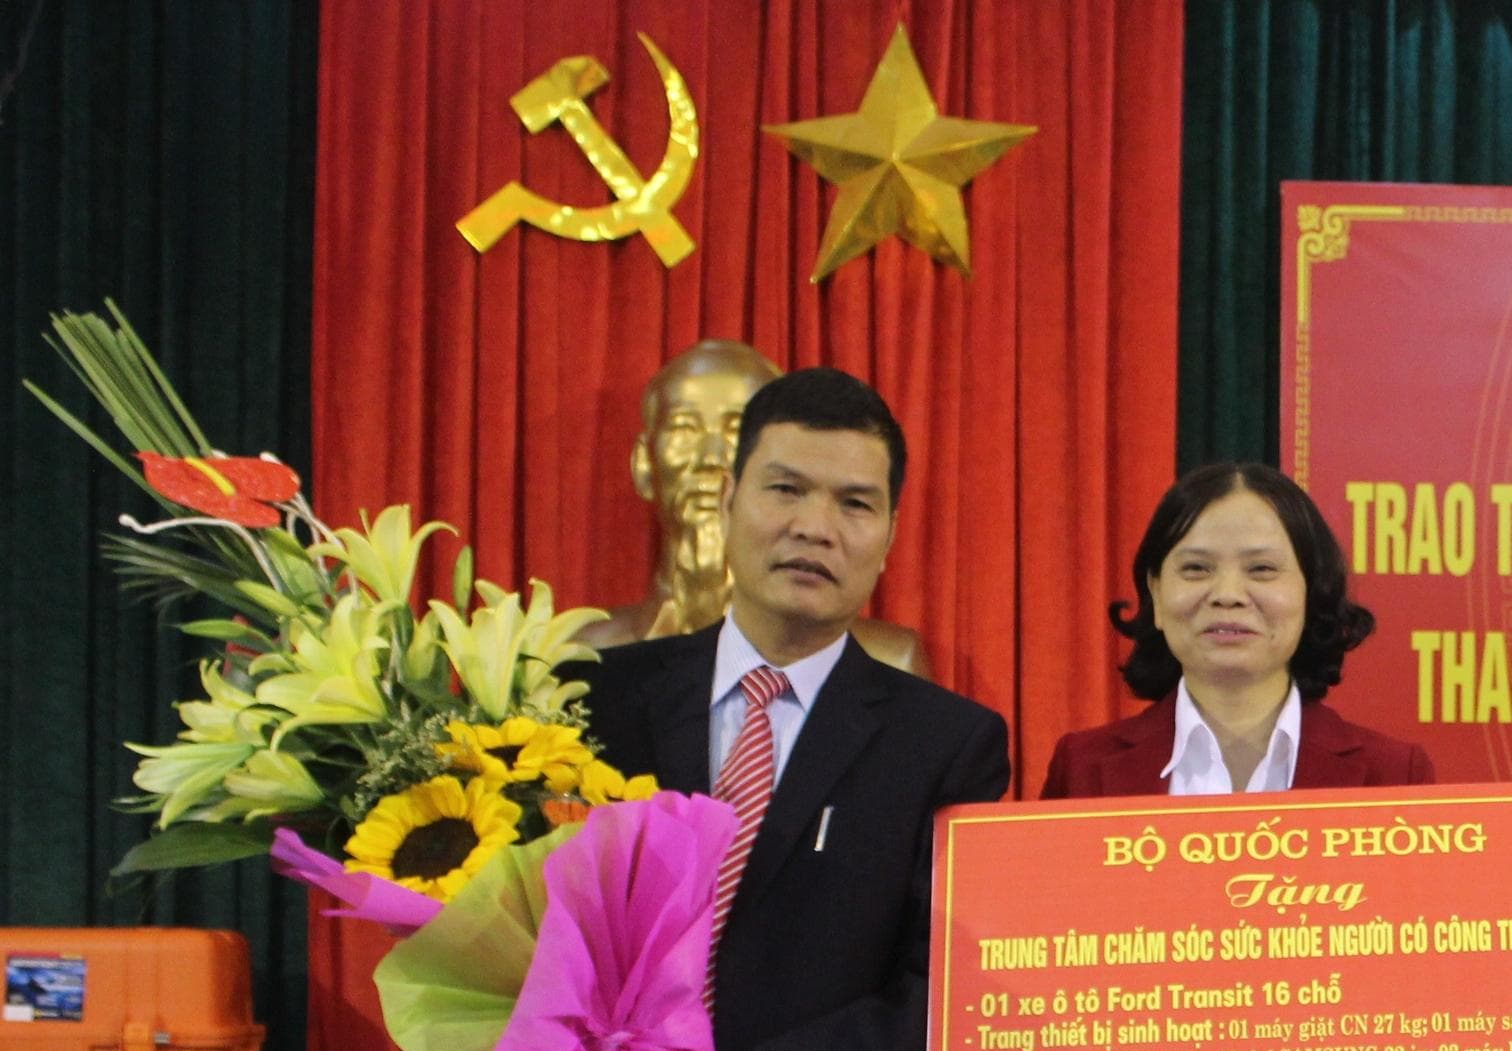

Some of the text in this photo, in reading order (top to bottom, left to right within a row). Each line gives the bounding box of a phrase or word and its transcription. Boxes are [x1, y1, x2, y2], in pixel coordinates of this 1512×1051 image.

[1346, 481, 1476, 576] TRAO
[1103, 816, 1488, 873] BỘ QUỐC PHÒNG
[1225, 873, 1366, 914] Tặng
[979, 937, 1047, 971] TRUNG
[1053, 928, 1098, 967] TÂM
[1105, 926, 1165, 965] CHĂM
[1173, 923, 1213, 963] SÓC
[1220, 920, 1261, 960] SỨC
[1269, 913, 1323, 959] KHỎE
[1330, 916, 1393, 956] NGƯỜI
[1400, 915, 1427, 955] CÓ
[1435, 914, 1491, 954] CÔNG
[981, 972, 1341, 1018] 01 xe ô tô Ford Transit 16 chỗ
[1041, 1016, 1087, 1047] thiết
[1094, 1020, 1111, 1051] bị
[1119, 1019, 1159, 1045] sinh
[1229, 1019, 1248, 1040] 01
[1255, 1017, 1293, 1041] máy
[1299, 1016, 1334, 1042] giặt
[1341, 1013, 1368, 1036] CN
[1374, 1013, 1394, 1035] 27
[1400, 1012, 1427, 1038] kg;
[1431, 1011, 1451, 1033] 01
[1458, 1010, 1496, 1036] máy
